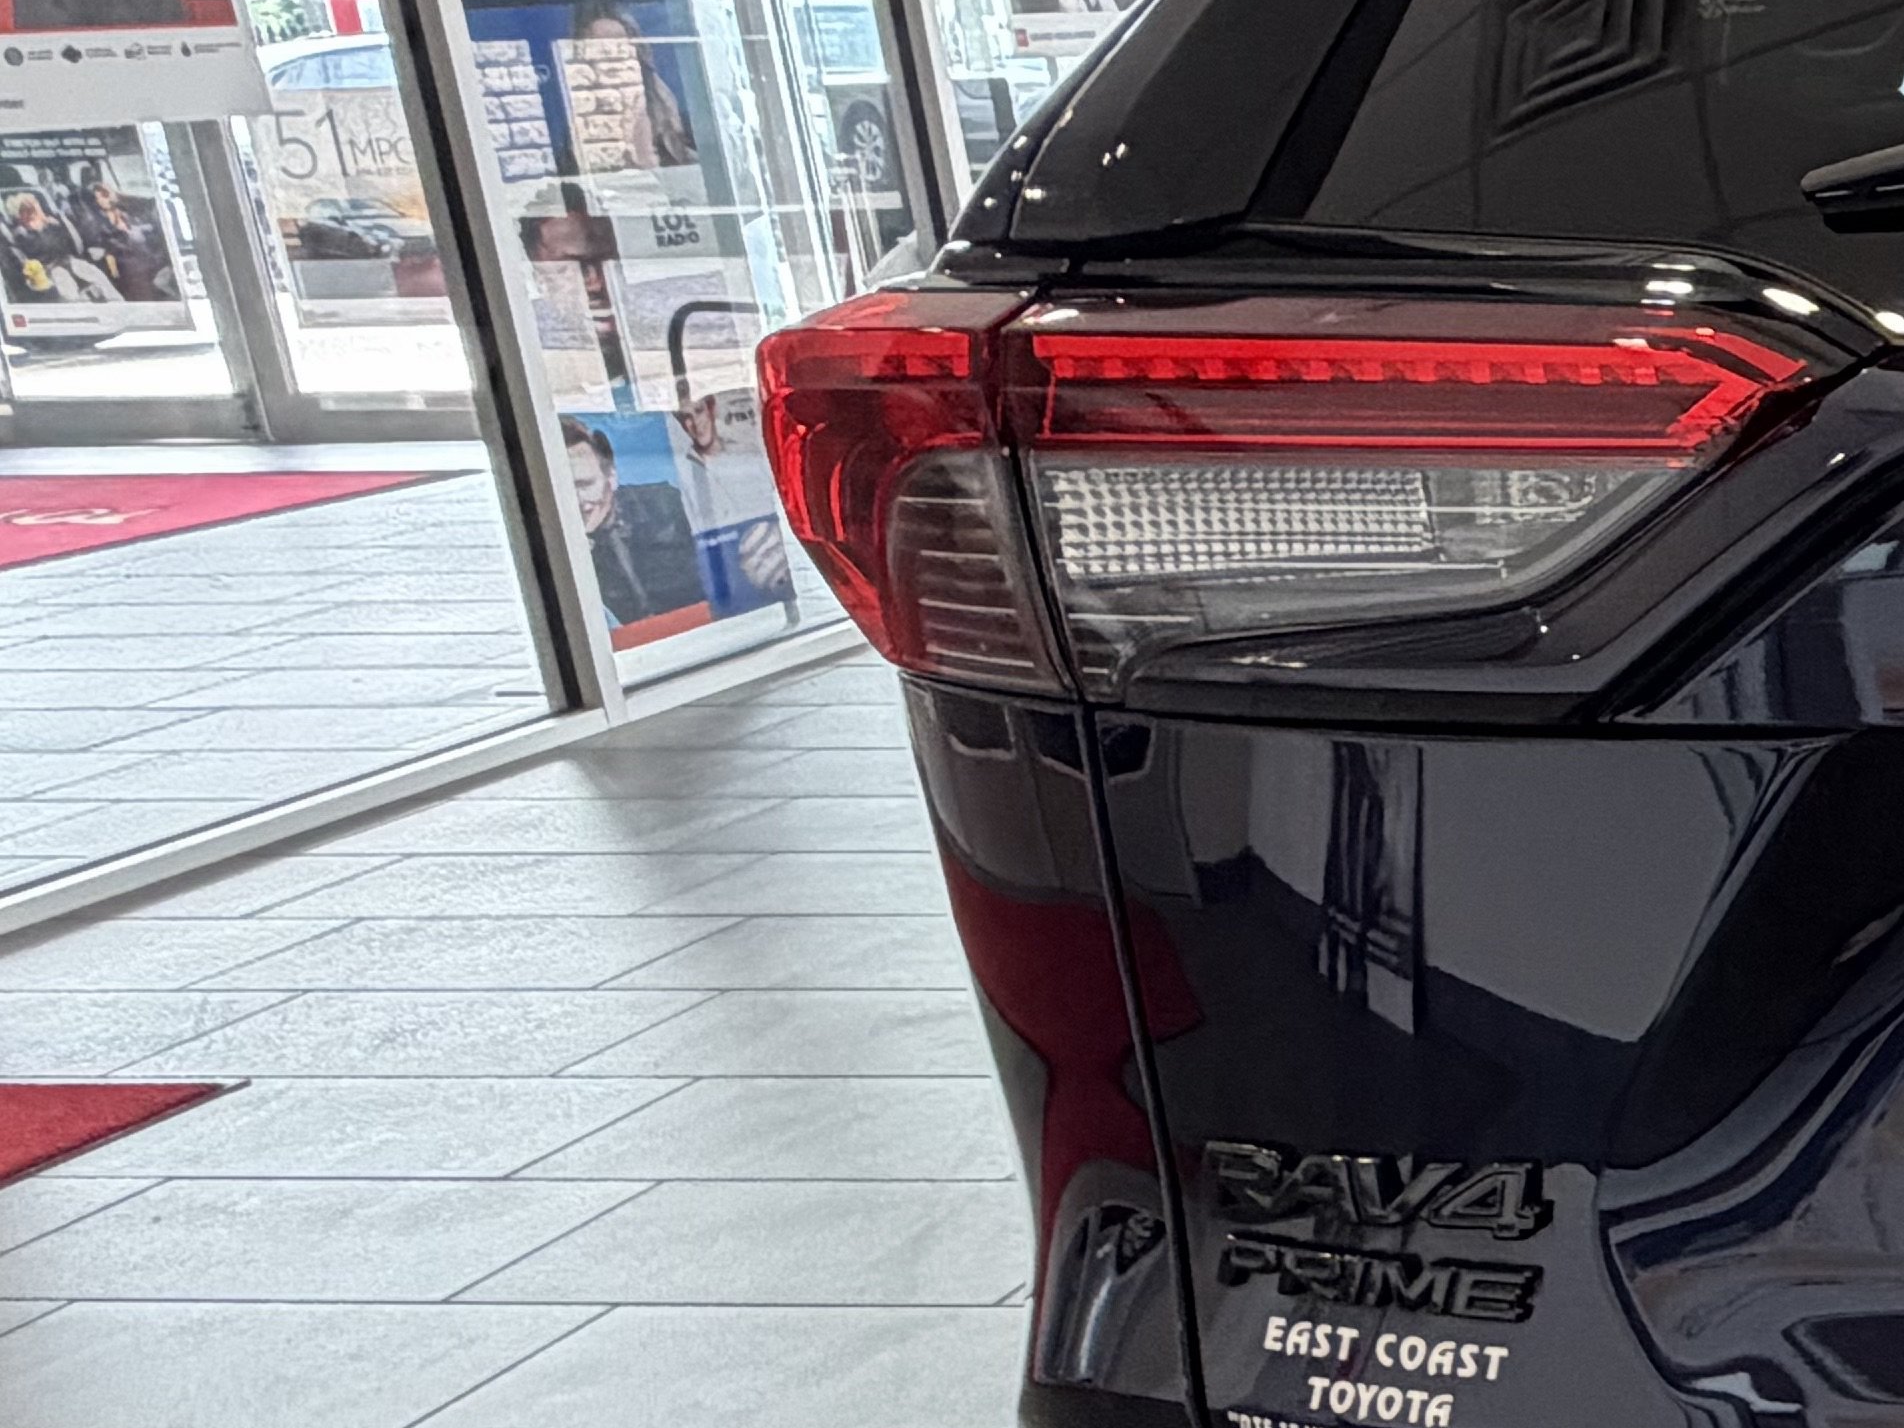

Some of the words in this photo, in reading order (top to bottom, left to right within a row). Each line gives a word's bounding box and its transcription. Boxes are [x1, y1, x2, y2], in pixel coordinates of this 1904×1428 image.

[275, 109, 349, 180] 51
[1203, 1139, 1551, 1240] RAV4
[1217, 1231, 1543, 1323] PRIME
[1263, 1316, 1359, 1362] EAST
[1375, 1332, 1509, 1381] COAST
[1307, 1376, 1454, 1428] TOYOTA
